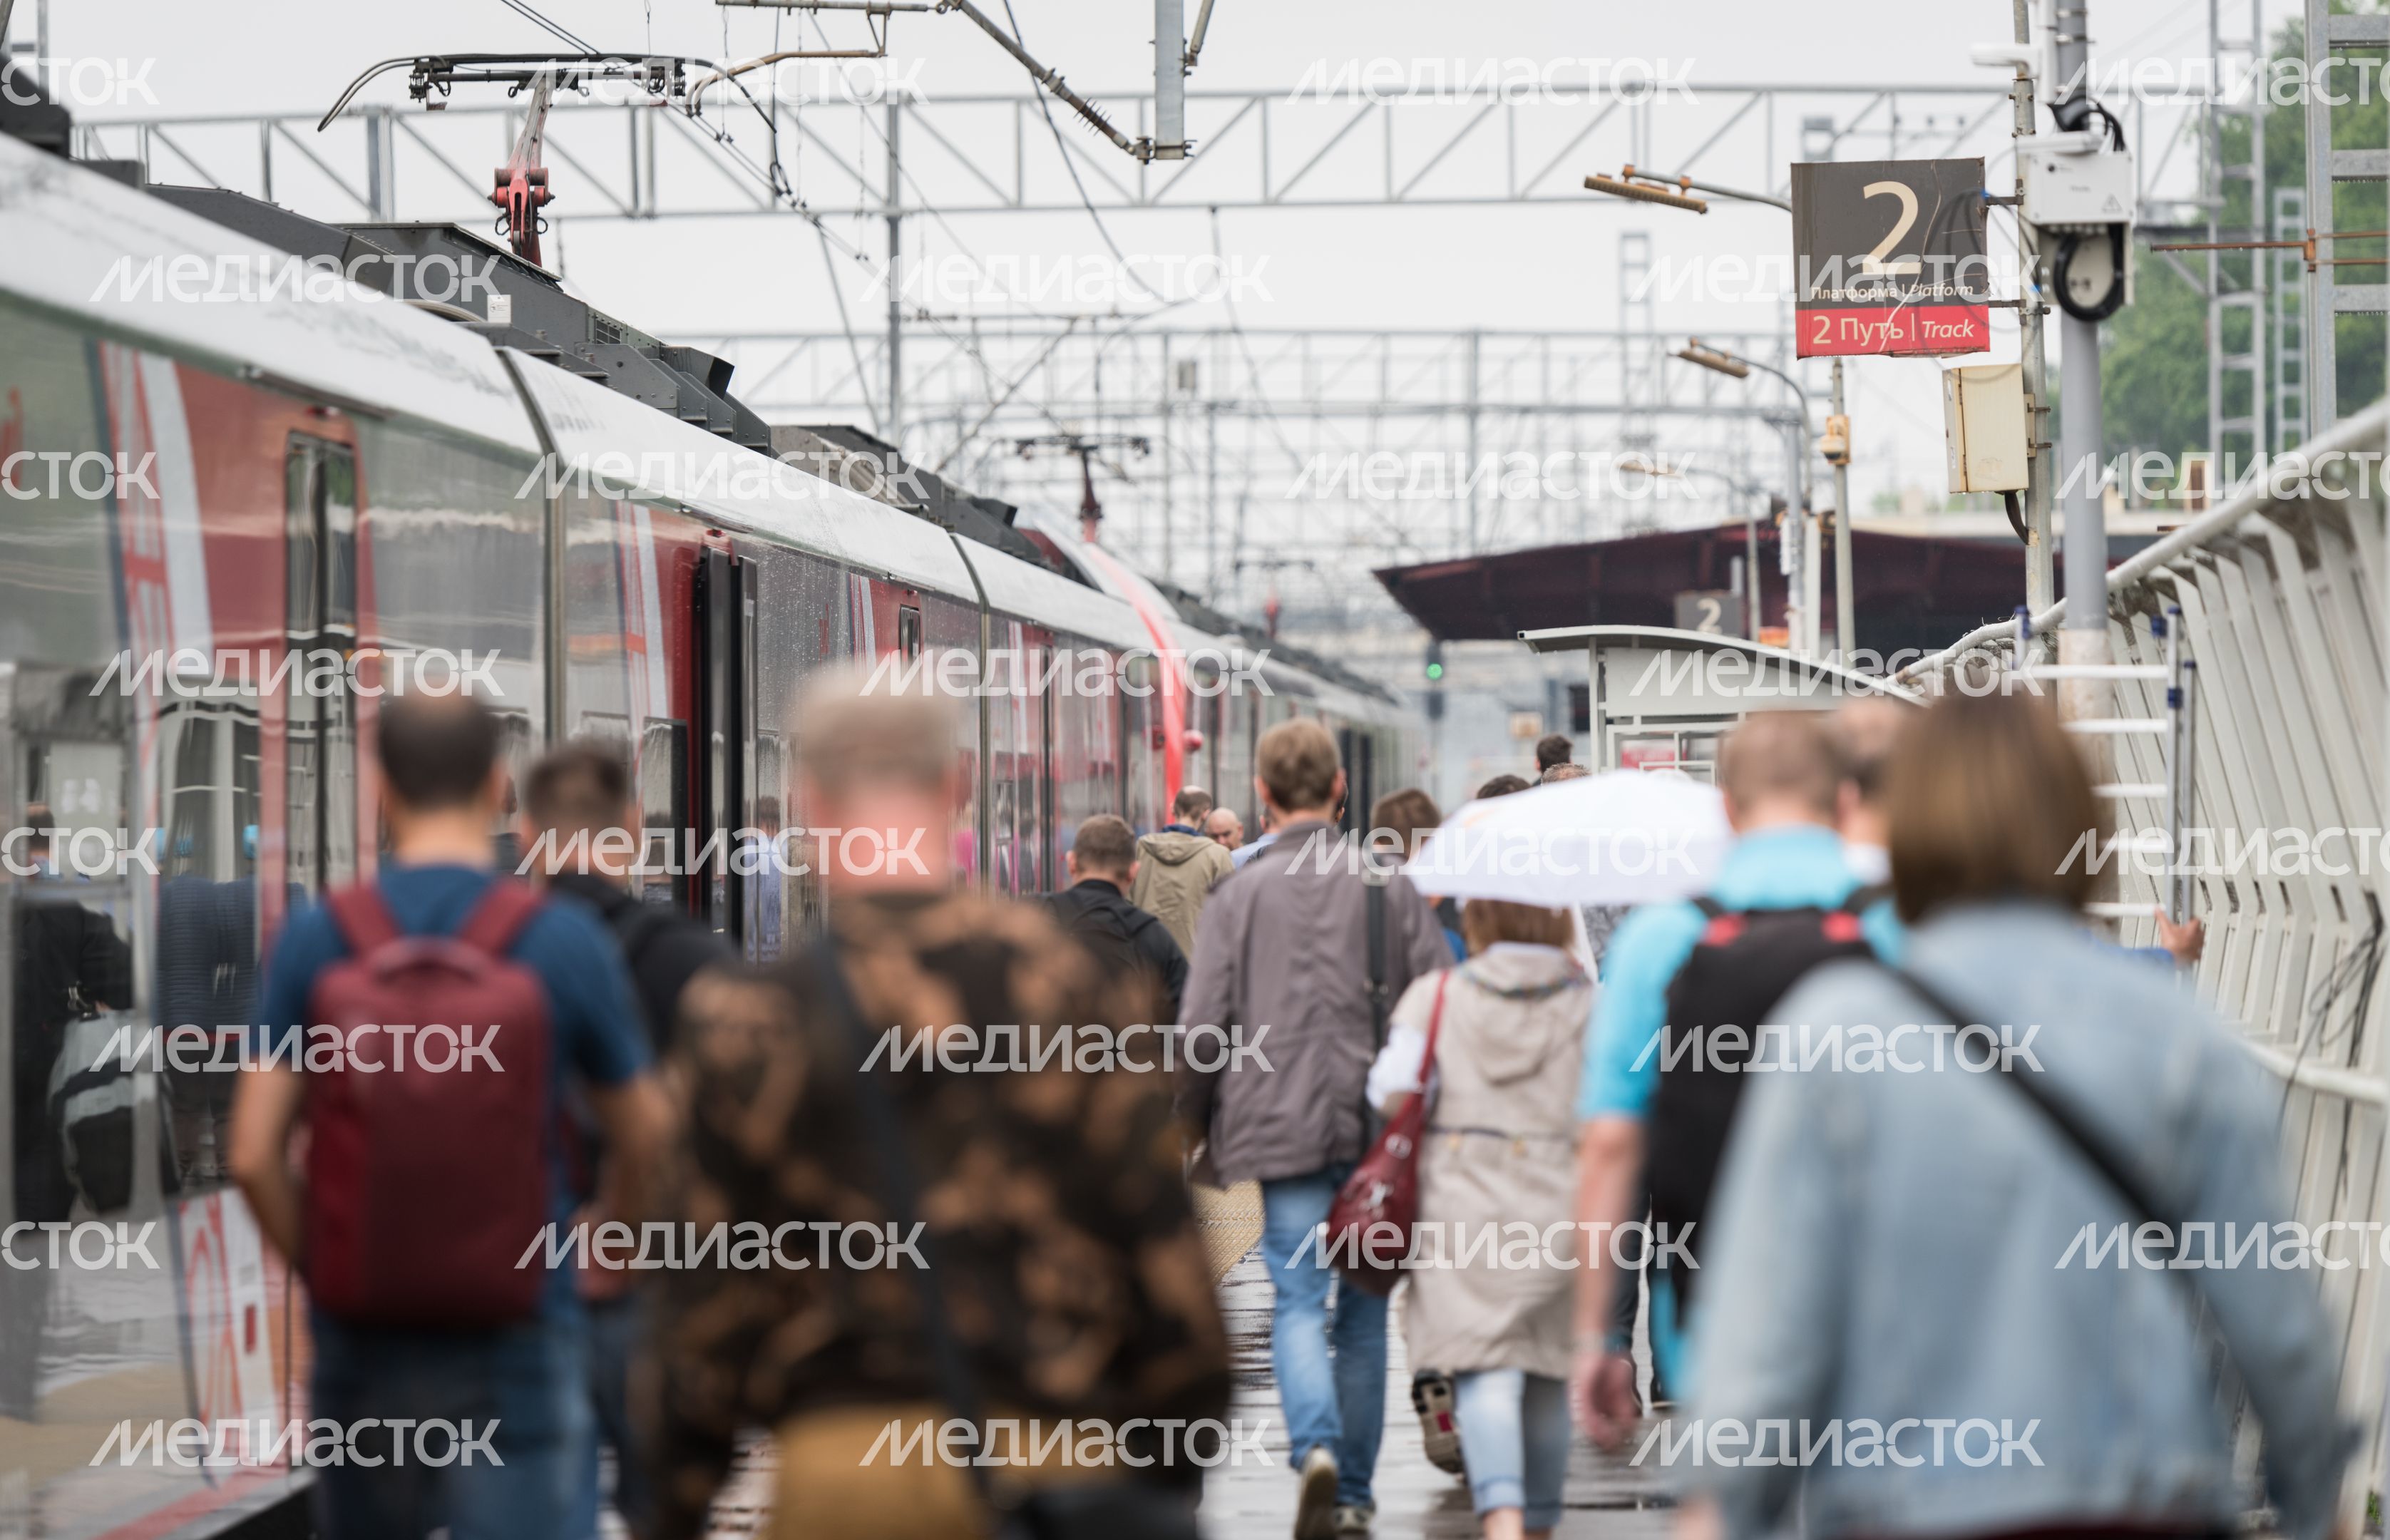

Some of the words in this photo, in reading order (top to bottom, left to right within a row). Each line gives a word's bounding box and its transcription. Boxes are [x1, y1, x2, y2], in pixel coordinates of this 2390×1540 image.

[1862, 180, 1922, 275] 2
[1810, 287, 1897, 302] Платформа
[1909, 282, 1974, 297] Platform
[1812, 315, 1832, 344] 2
[1840, 317, 1904, 346] Путь
[1922, 319, 1975, 339] Track
[1697, 597, 1723, 635] 2
